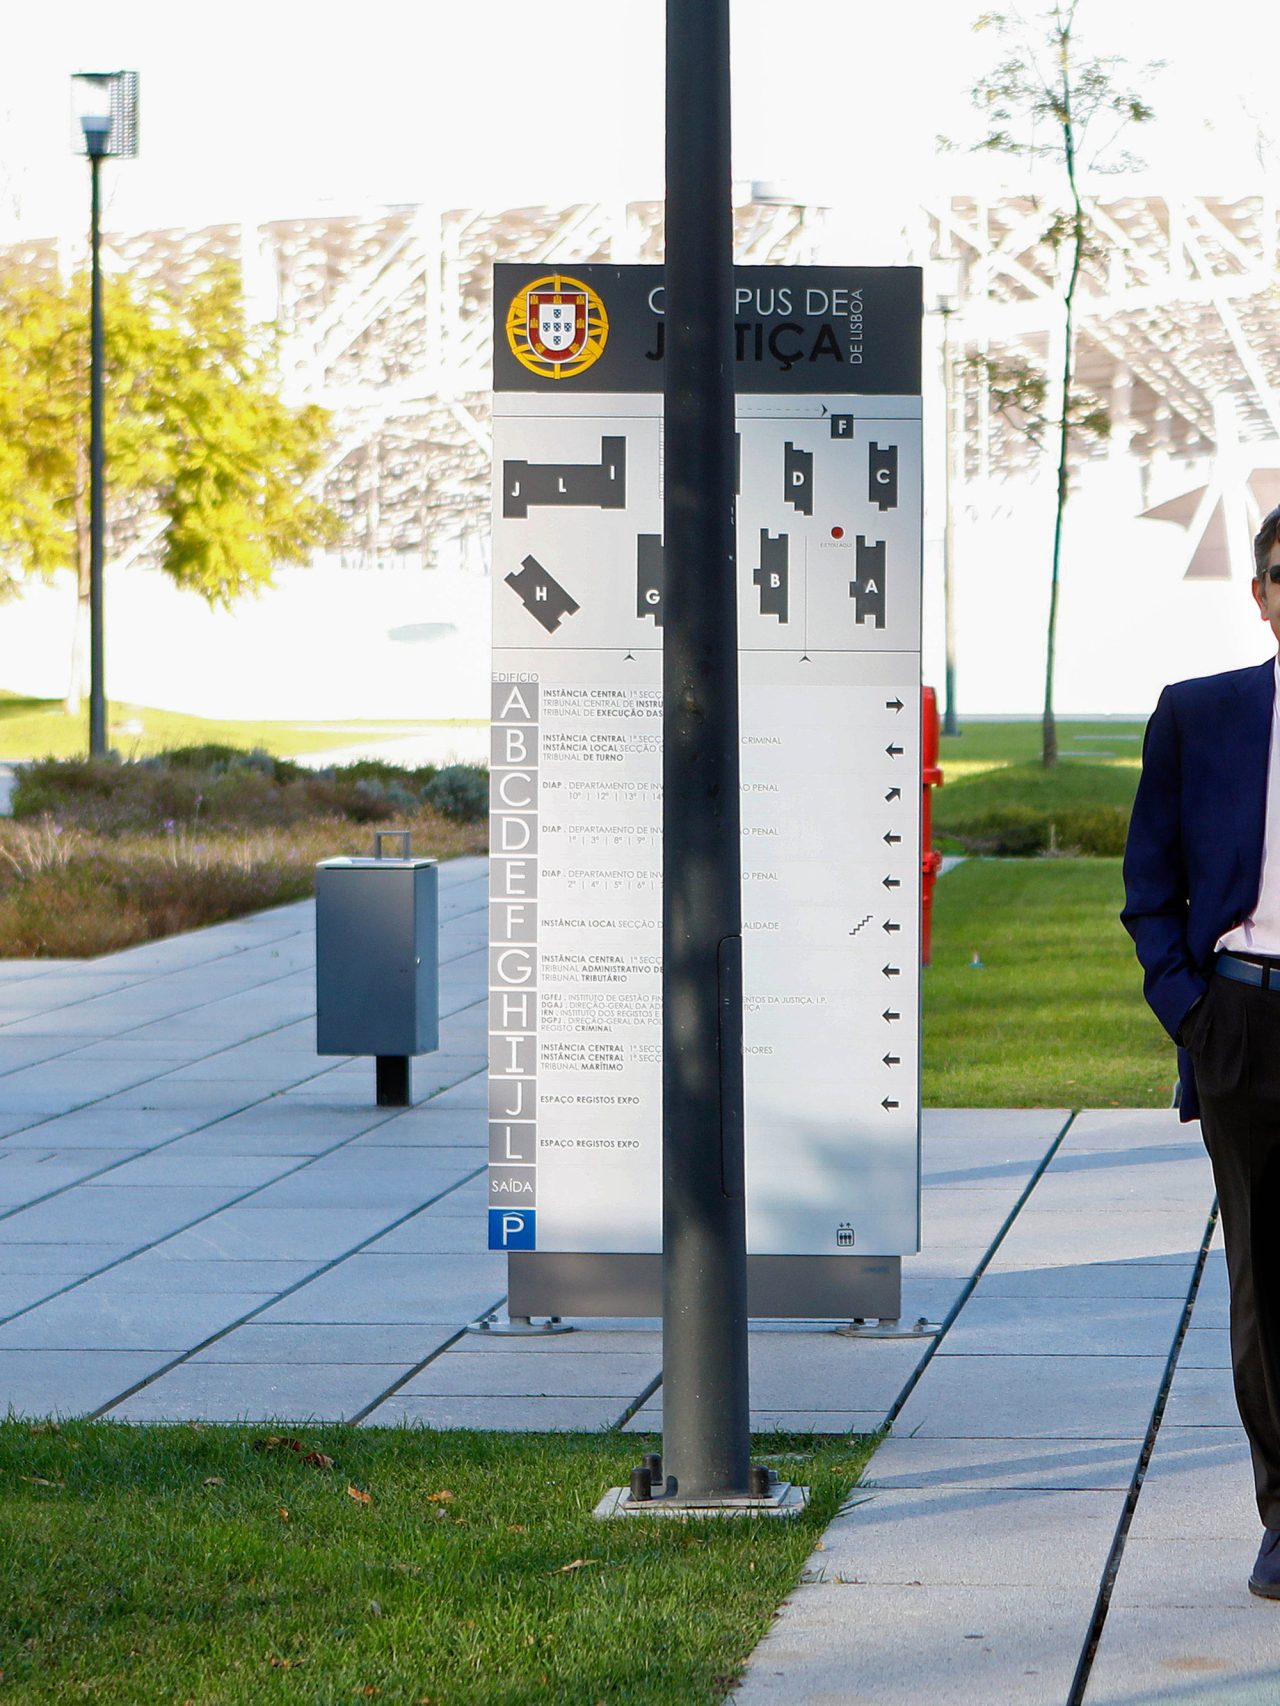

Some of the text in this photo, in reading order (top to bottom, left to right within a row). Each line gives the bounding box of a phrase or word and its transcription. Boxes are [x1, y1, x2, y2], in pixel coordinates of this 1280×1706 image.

[648, 287, 848, 316] CPUS DE
[850, 289, 863, 364] DE LISBOA
[645, 322, 843, 371] JTIÇA
[838, 420, 847, 434] F
[610, 466, 615, 479] I
[793, 472, 804, 486] D
[877, 469, 890, 484] C
[512, 482, 520, 497] J
[559, 478, 566, 493] L
[770, 574, 780, 588] B
[865, 580, 878, 594] A
[536, 587, 547, 601] H
[645, 590, 660, 604] G
[544, 689, 588, 697] INSTÂNCIA
[639, 691, 661, 699] SECÇ
[500, 686, 531, 719] A
[597, 709, 643, 718] EXECUÇÃO
[507, 729, 527, 762] B
[543, 743, 587, 751] INSTÂNCIA
[619, 745, 656, 753] SECÇÃO
[500, 772, 531, 807] C
[569, 782, 635, 790] DEPARTAMENTO
[752, 784, 779, 792] PENAL
[502, 817, 530, 850] D
[506, 862, 525, 894] E
[507, 905, 524, 939] F
[618, 920, 655, 929] SECÇÃO
[498, 949, 532, 983] G
[542, 955, 585, 963] INSTÂNCIA
[542, 964, 579, 972] TRIBUNAL
[582, 965, 651, 973] ADMINISTRATIVO
[582, 974, 627, 982] TRIBUTÁRIO
[619, 994, 649, 1002] GESTÃO
[503, 994, 527, 1027] H
[506, 1037, 524, 1073] I
[541, 1043, 585, 1051] INSTÂNCIA
[639, 1045, 661, 1053] SECÇ
[541, 1053, 585, 1061] INSTÂNCIA
[541, 1062, 623, 1071] TRIBUNAL MARÍTIMO
[506, 1082, 522, 1115] J
[541, 1096, 573, 1104] ESPAÇO
[506, 1127, 522, 1159] L
[541, 1139, 573, 1148] ESPAÇO
[577, 1140, 615, 1148] REGISTOS
[492, 1178, 533, 1192] SAÍDA
[503, 1216, 524, 1246] P
